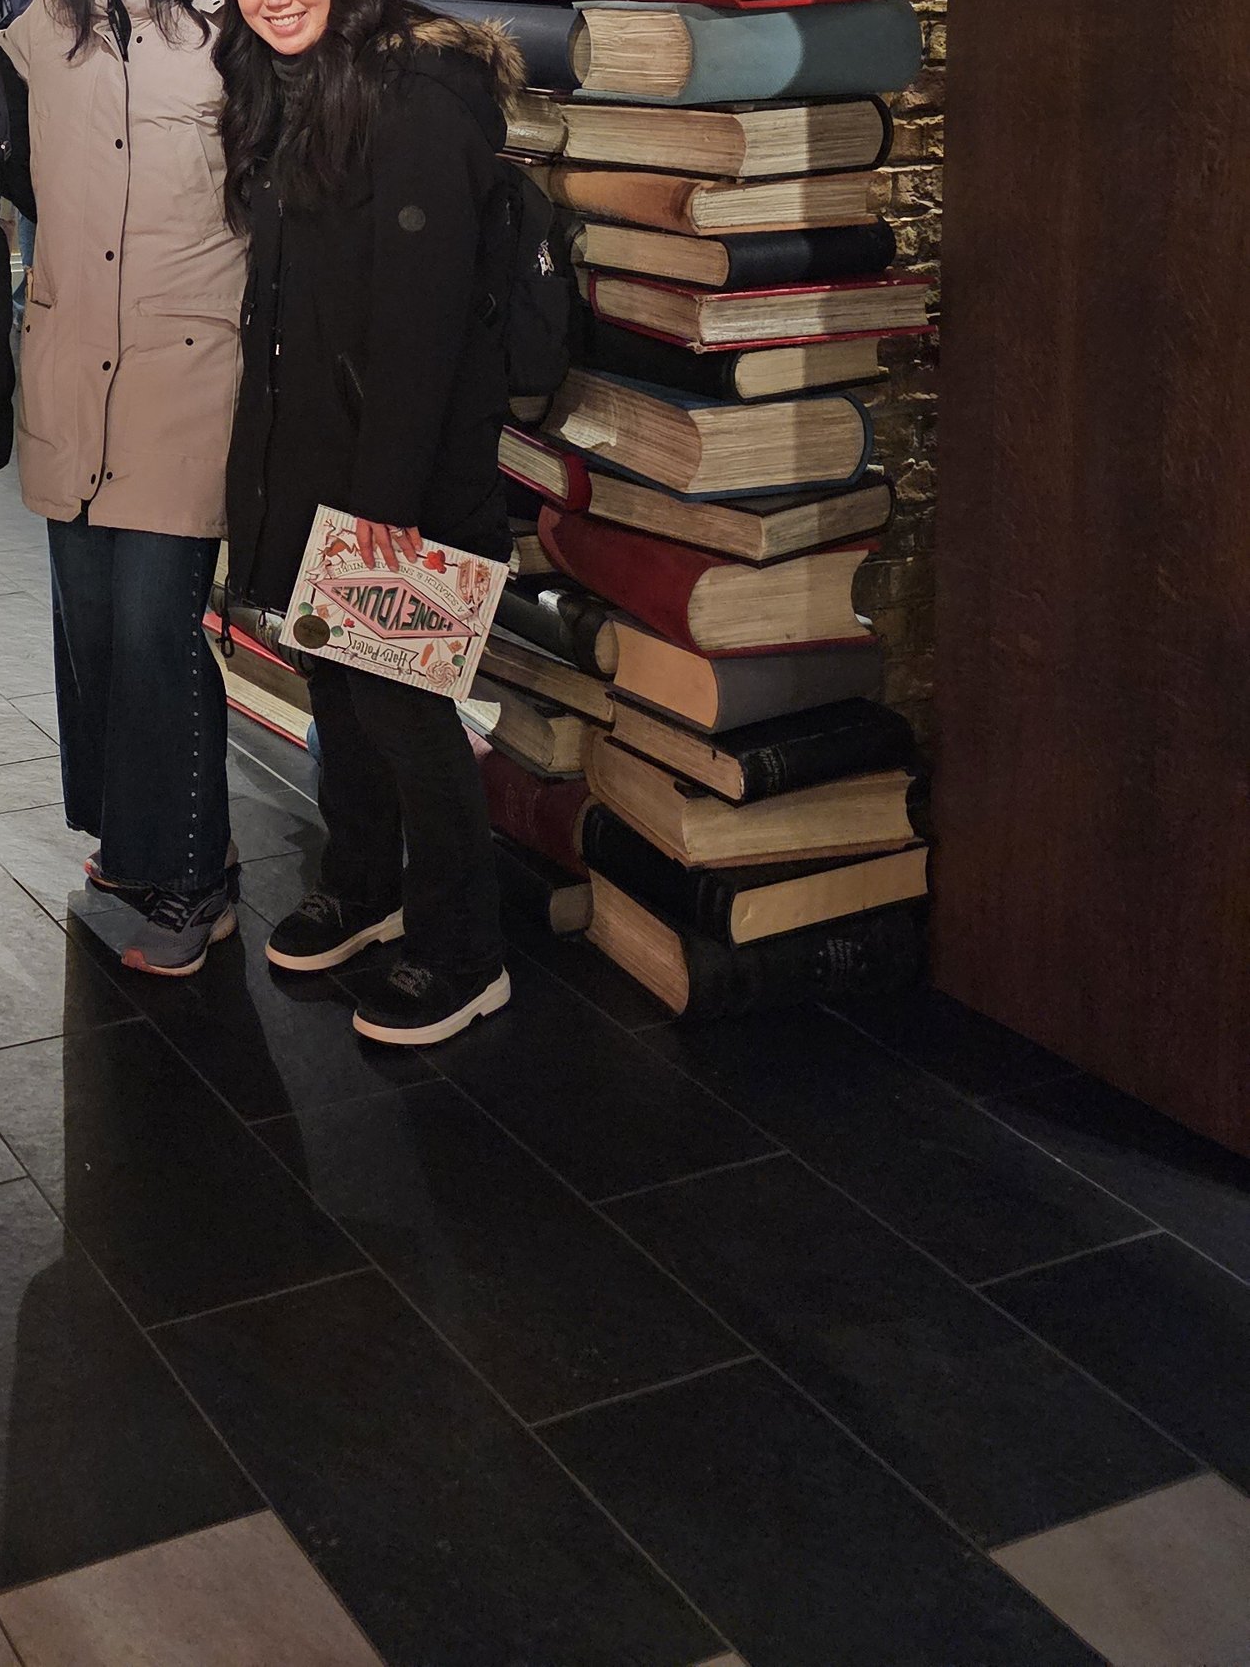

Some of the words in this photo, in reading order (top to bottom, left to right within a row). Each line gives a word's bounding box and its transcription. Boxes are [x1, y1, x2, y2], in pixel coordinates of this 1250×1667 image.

[335, 561, 386, 576] ADNTURE
[424, 575, 460, 607] SCRATCH
[351, 638, 382, 661] Potter
[377, 648, 409, 668] Harry
